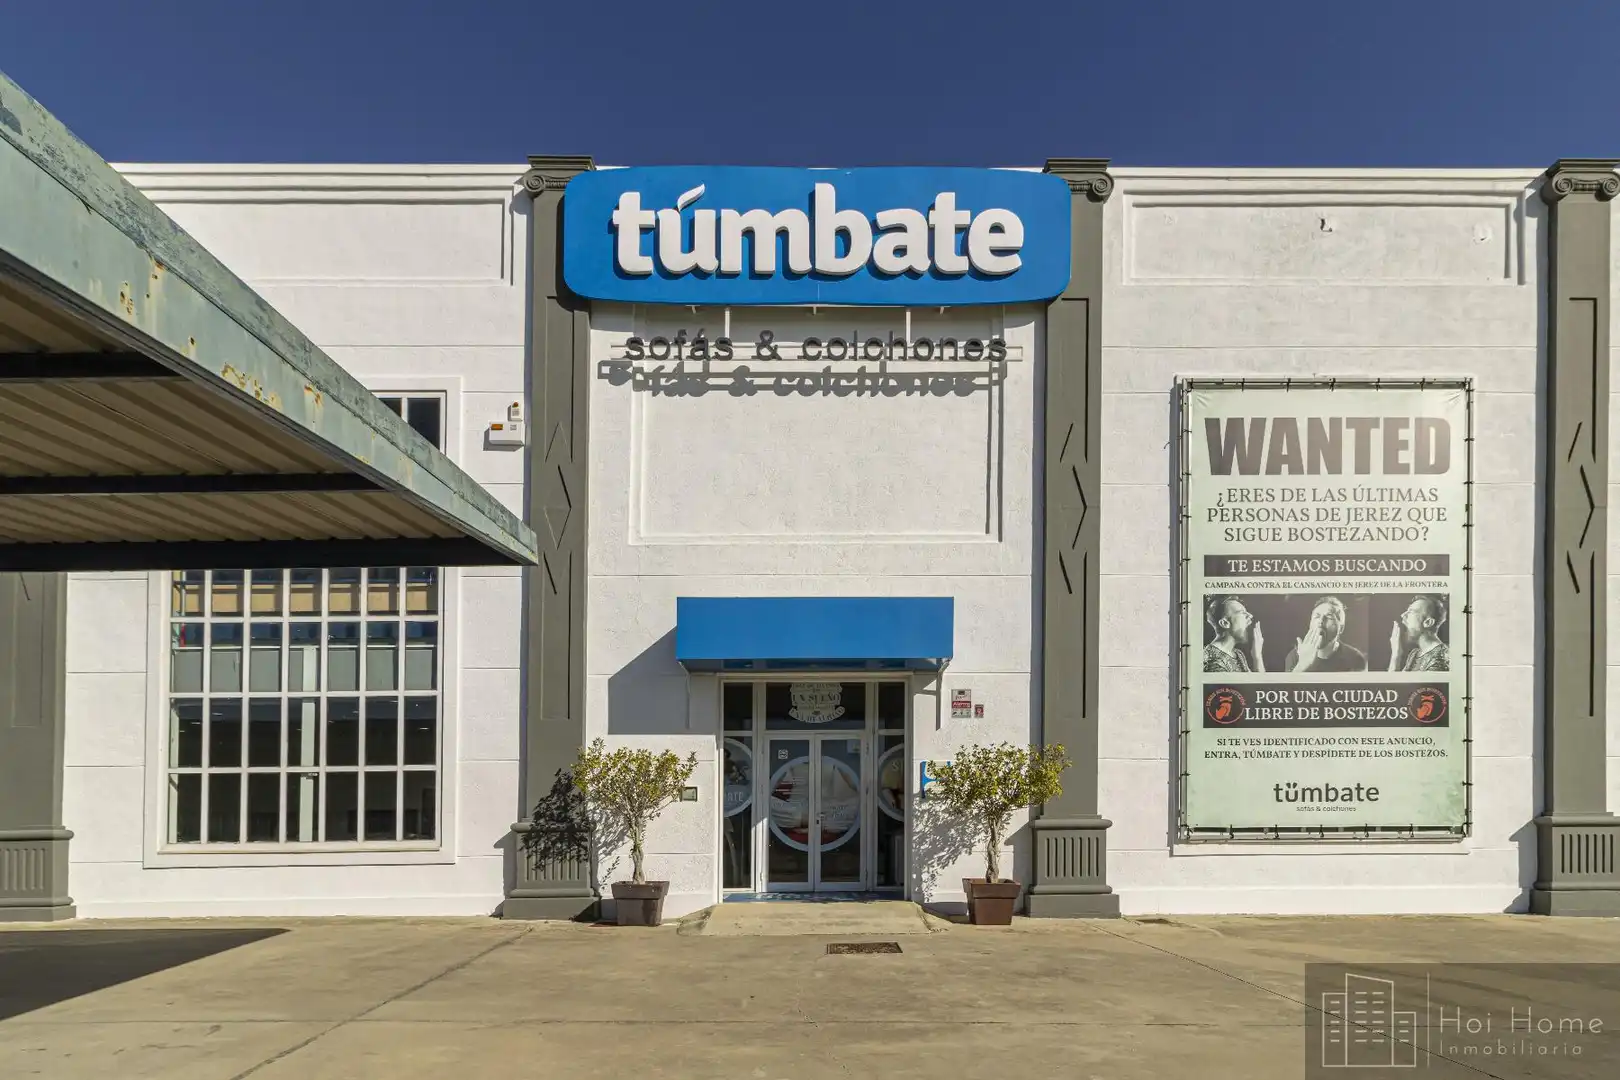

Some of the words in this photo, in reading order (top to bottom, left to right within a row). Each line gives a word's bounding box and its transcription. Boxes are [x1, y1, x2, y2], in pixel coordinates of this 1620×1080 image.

[612, 182, 1025, 276] túmbate
[624, 328, 734, 361] sofás
[752, 329, 781, 361] &
[801, 329, 1007, 361] colchones
[1204, 417, 1451, 476] WANTED
[1216, 487, 1275, 507] ¿ERES
[1280, 488, 1306, 503] DE
[1312, 488, 1347, 503] LAS
[1353, 484, 1439, 503] ÚLTIMAS
[1207, 508, 1310, 523] PERSONAS
[1315, 508, 1341, 522] DE
[1345, 508, 1402, 526] JEREZ
[1407, 507, 1447, 525] QUE
[1224, 526, 1283, 542] SIGUE
[1288, 526, 1429, 542] BOSTEZANDO?
[1228, 559, 1248, 573] TE
[1251, 559, 1330, 573] ESTAMOS
[1334, 559, 1427, 573] BUSCANDO
[1204, 579, 1246, 589] CAMPAÑA
[1355, 581, 1379, 589] JEREZ
[1405, 580, 1449, 588] FRONTERA
[1255, 690, 1289, 704] POR
[1294, 691, 1329, 703] UNA
[1332, 690, 1398, 703] CIUDAD
[1244, 707, 1293, 720] LIBRE
[1297, 707, 1320, 720] DE
[1324, 706, 1409, 720] BOSTEZOS
[1217, 738, 1226, 746] SI
[1228, 738, 1241, 746] TE
[1243, 738, 1261, 746] VES
[1263, 737, 1336, 746] IDENTIFICADO
[1338, 737, 1359, 745] CON
[1361, 737, 1385, 745] ESTE
[1387, 737, 1436, 747] ANUNCIO,
[1204, 750, 1241, 759] ENTRA,
[1243, 748, 1293, 758] TÚMBATE
[1294, 750, 1300, 758] Y
[1301, 748, 1356, 758] DESPÍDETE
[1358, 750, 1372, 758] DE
[1374, 750, 1392, 758] LOS
[1394, 749, 1448, 758] BOSTEZOS.
